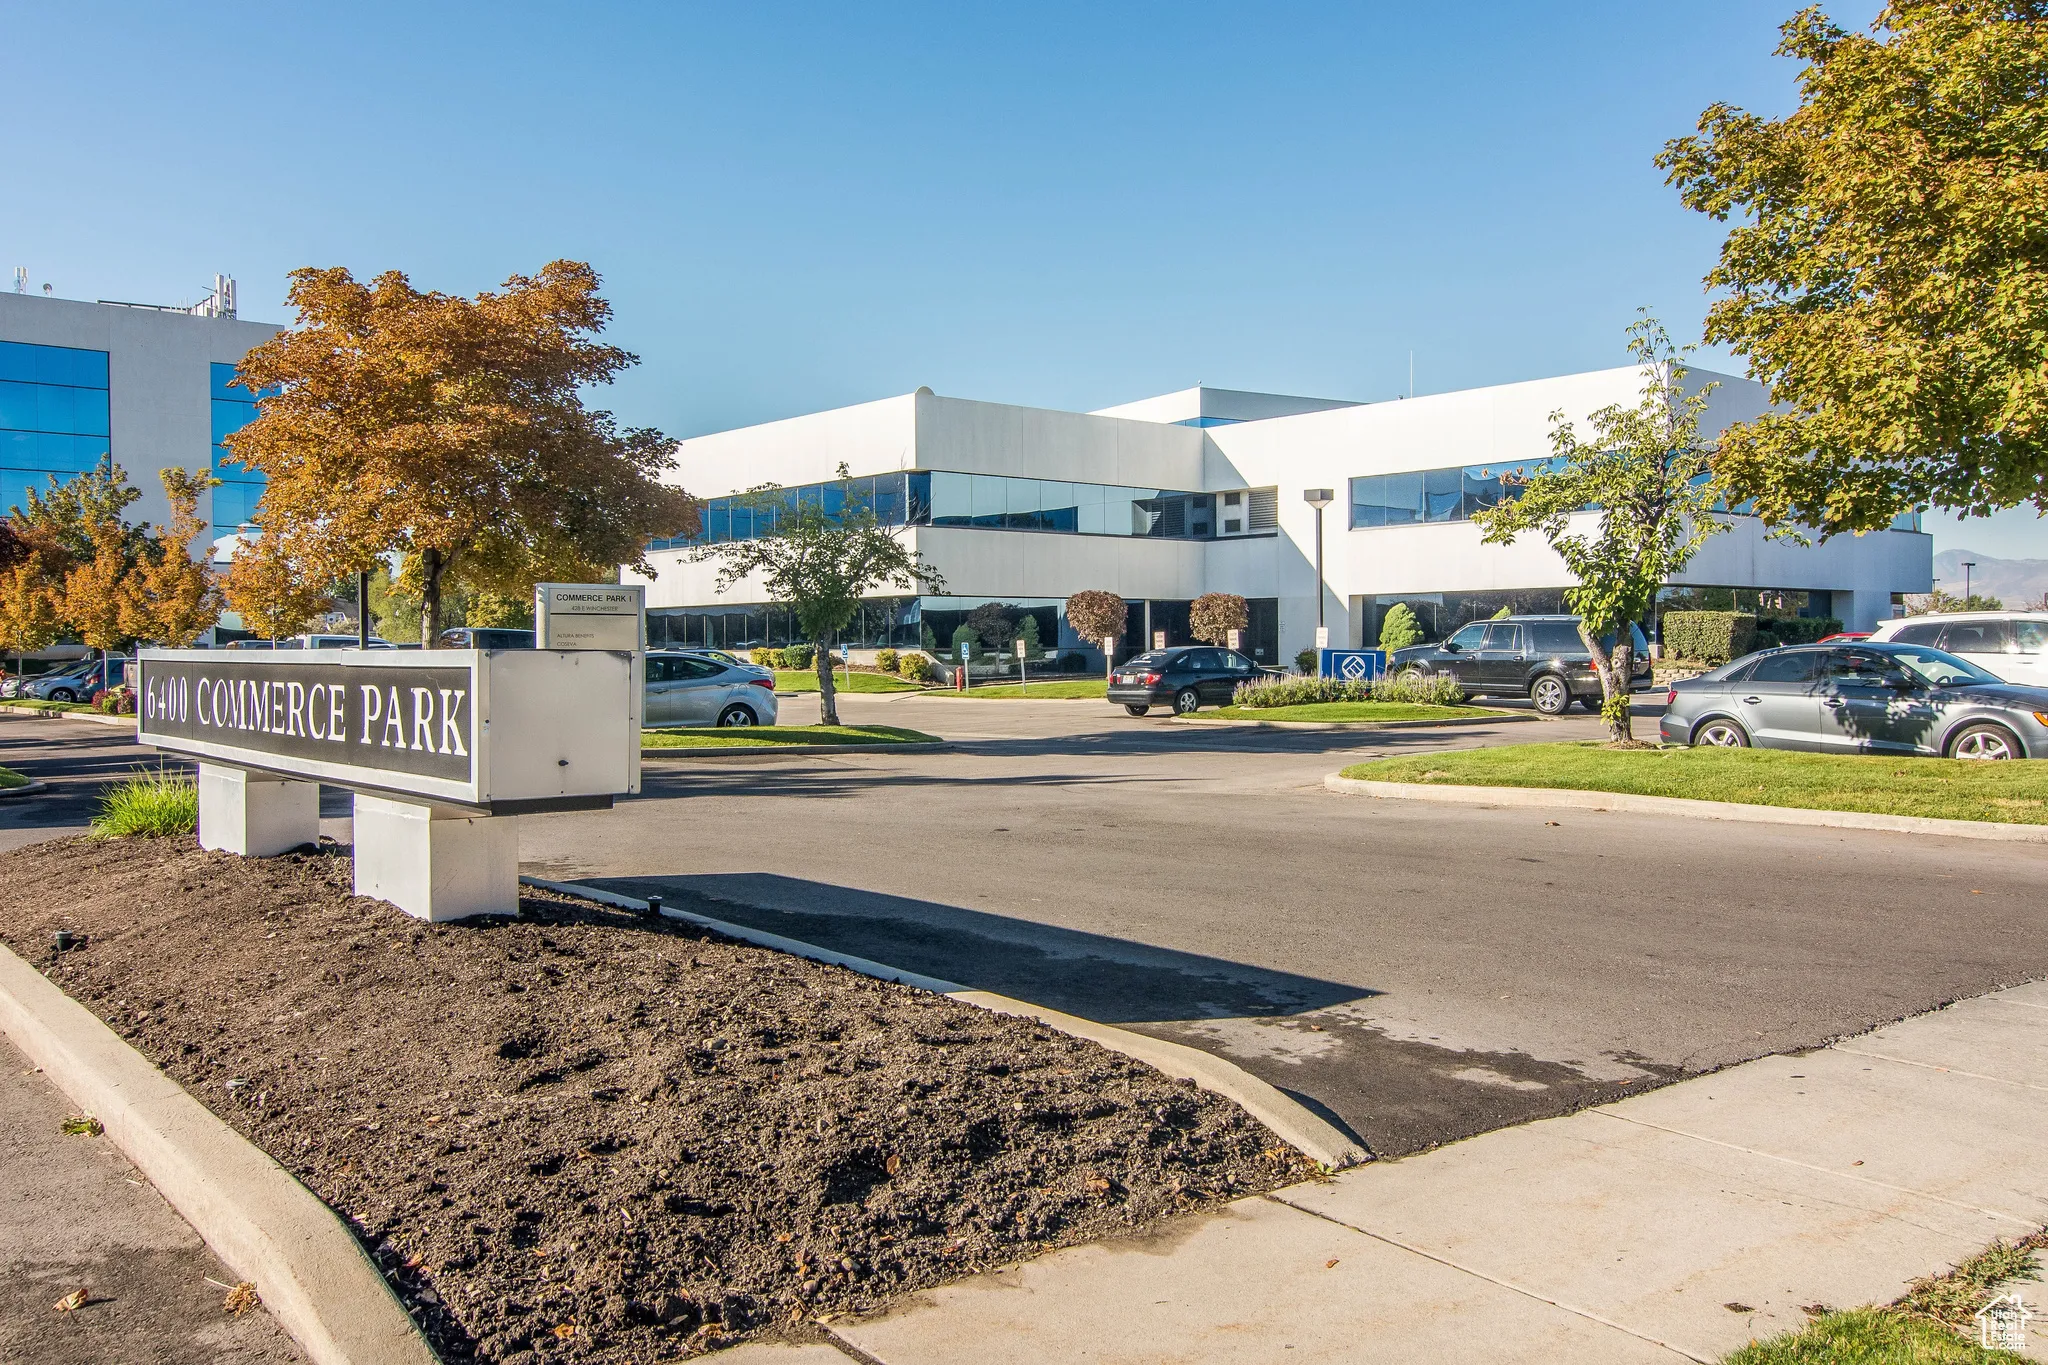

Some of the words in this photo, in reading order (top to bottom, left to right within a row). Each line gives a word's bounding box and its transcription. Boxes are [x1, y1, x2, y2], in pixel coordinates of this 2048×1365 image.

[556, 593, 603, 602] COMMERCE
[147, 675, 189, 723] 6400
[197, 677, 346, 742] COMMERCE
[360, 684, 468, 756] PARK
